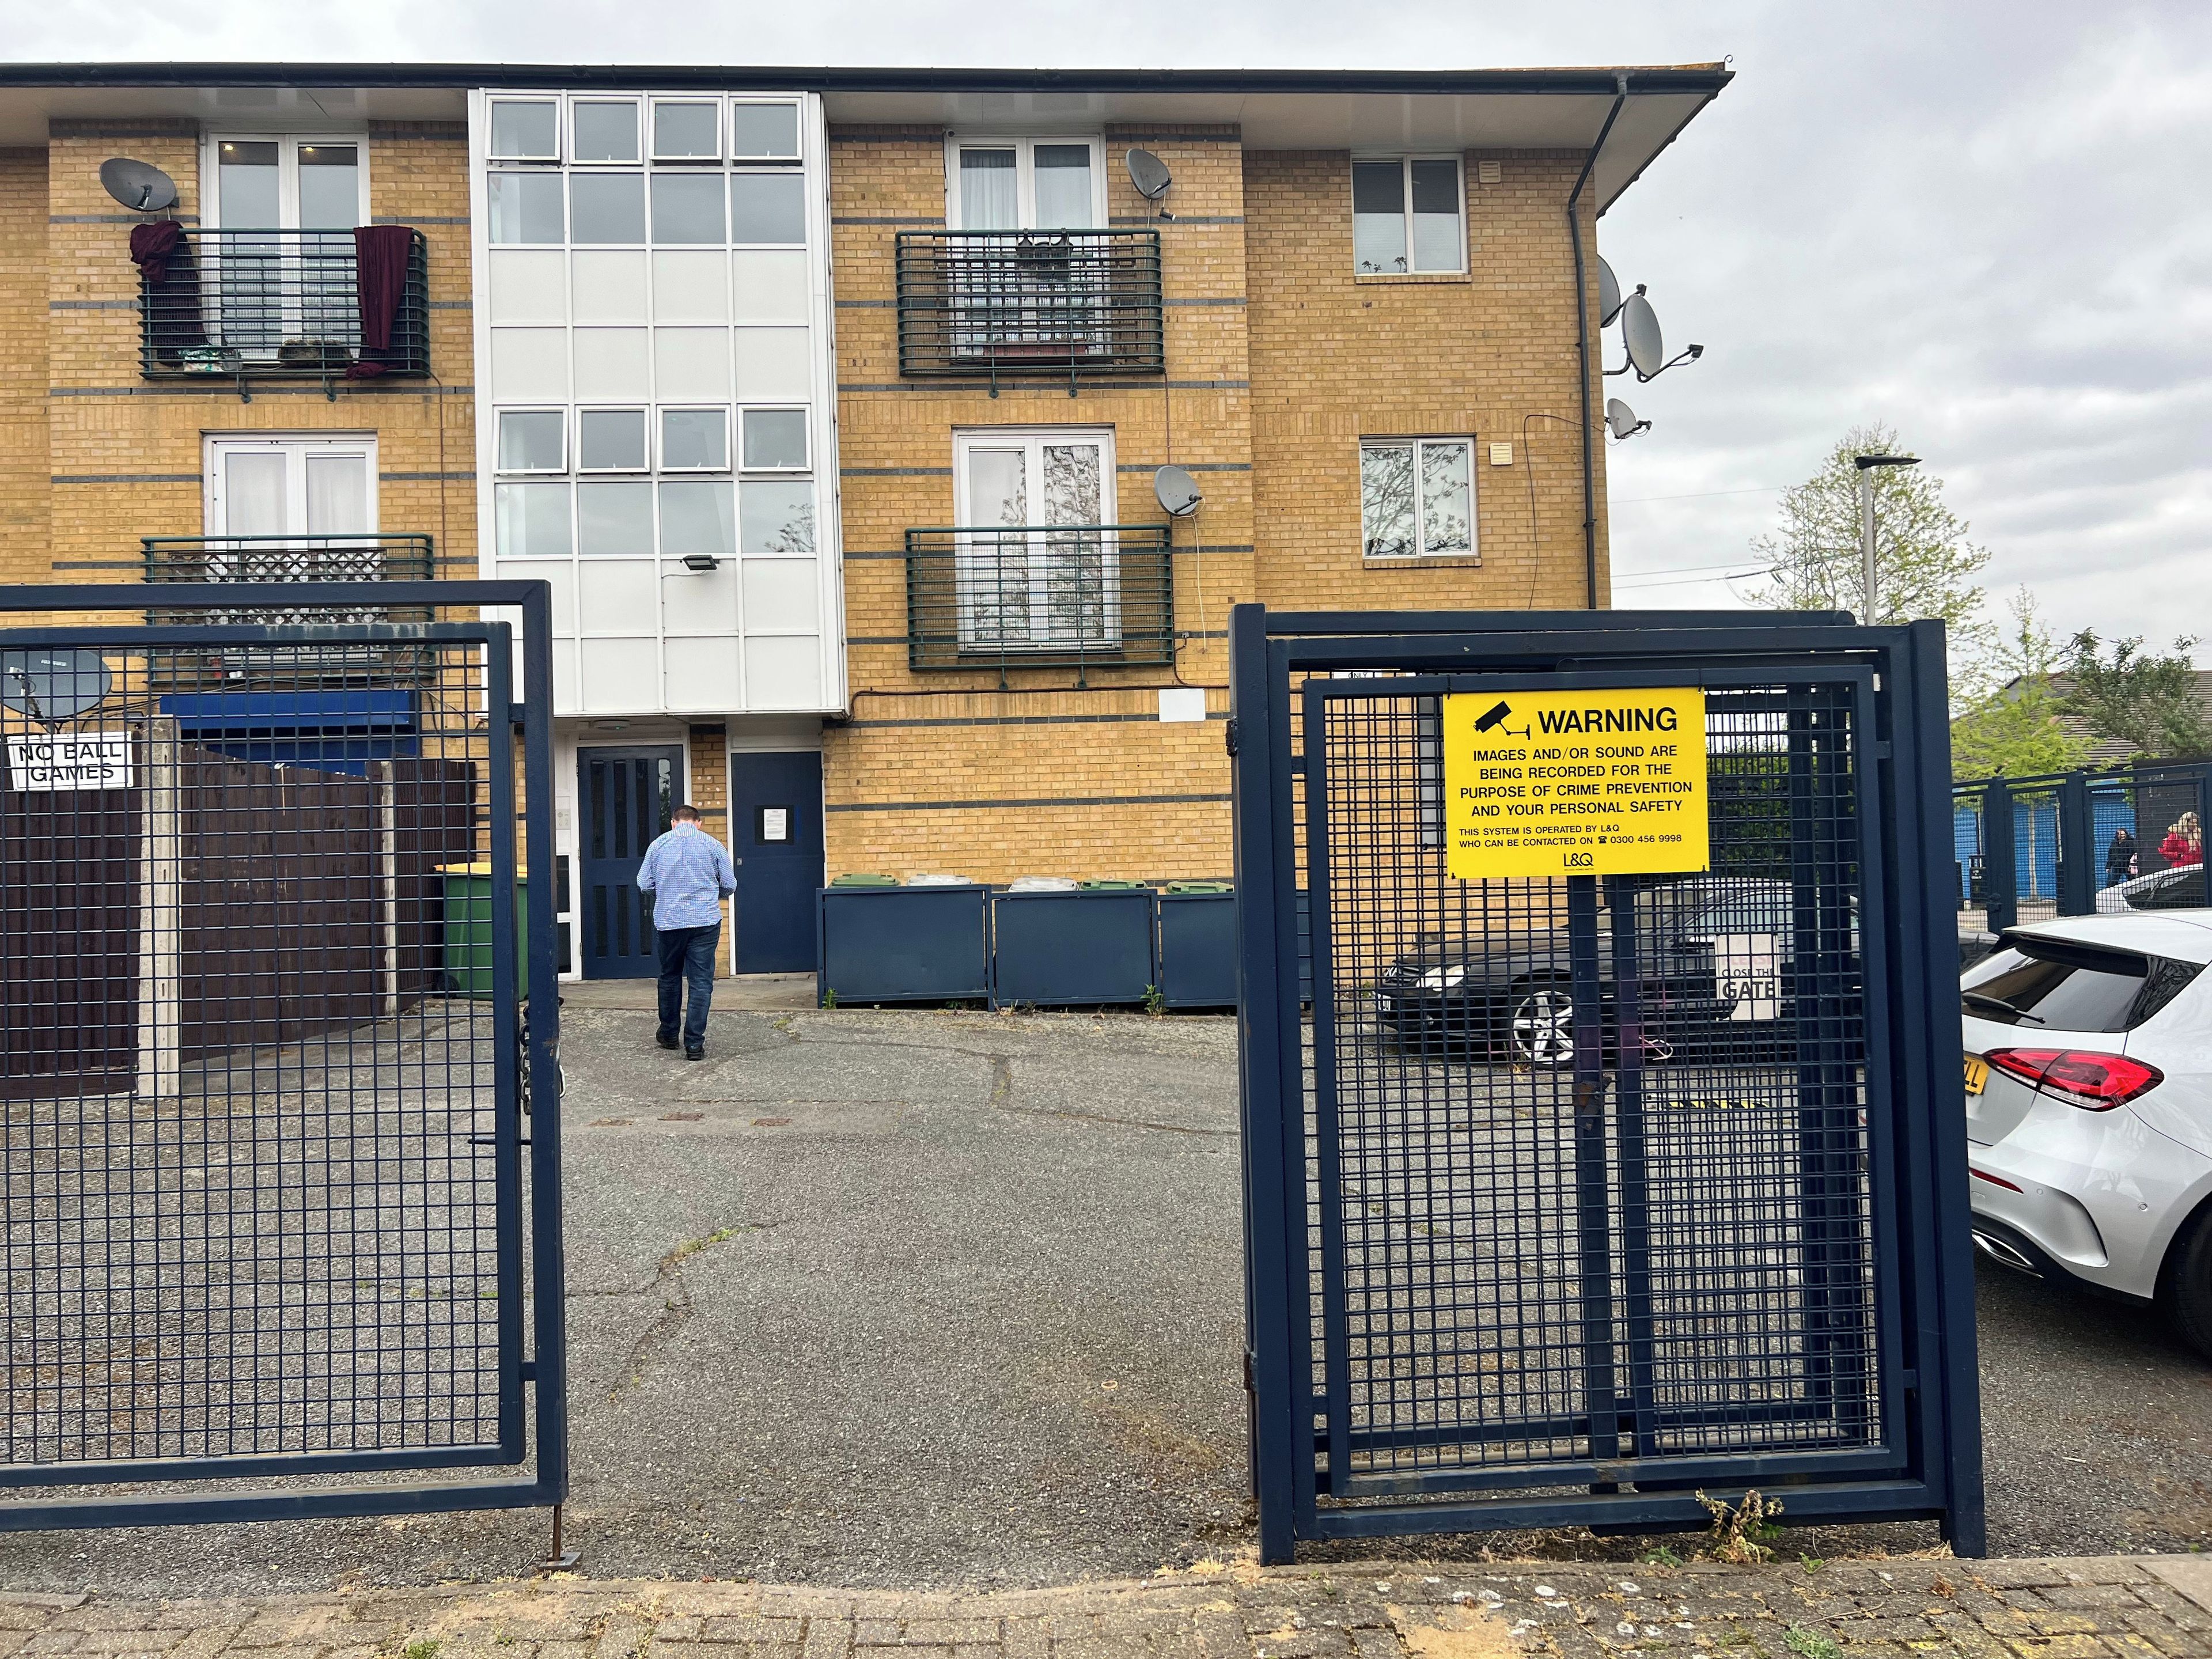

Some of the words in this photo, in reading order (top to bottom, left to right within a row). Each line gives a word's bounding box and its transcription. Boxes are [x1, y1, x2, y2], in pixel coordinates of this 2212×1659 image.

[1537, 707, 1677, 734] WARNING
[19, 744, 54, 762] NO
[64, 743, 122, 760] BALL
[1474, 749, 1527, 762] IMAGES
[1533, 747, 1589, 760] AND/OR
[1596, 746, 1644, 758] SOUND
[1650, 745, 1677, 757] ARE
[31, 763, 114, 782] GAMES
[1480, 768, 1522, 779] BEING
[1529, 766, 1605, 778] RECORDED
[1612, 764, 1639, 776] FOR
[1645, 764, 1672, 775] THE
[1460, 786, 1526, 798] PURPOSE
[1532, 785, 1551, 797] OF
[1556, 785, 1600, 796] CRIME
[1607, 782, 1692, 794] PREVENTION
[1471, 805, 1500, 817] AND
[1506, 803, 1544, 816] YOUR
[1550, 802, 1624, 815] PERSONAL
[1630, 800, 1683, 813] SAFETY
[1459, 828, 1479, 836] THIS
[1483, 827, 1519, 836] SYSTEM
[1523, 827, 1532, 835] IS
[1535, 825, 1582, 834] OPERATED
[1601, 824, 1620, 833] L&Q
[1459, 839, 1481, 848] WHO
[1484, 839, 1503, 847] CAN
[1507, 839, 1519, 847] BE
[1522, 837, 1576, 846] CONTACTED
[1610, 835, 1634, 844] 0300
[1638, 835, 1655, 843] 456
[1658, 834, 1682, 843] 9998
[1563, 853, 1594, 867] L&Q
[1722, 981, 1775, 999] GATE
